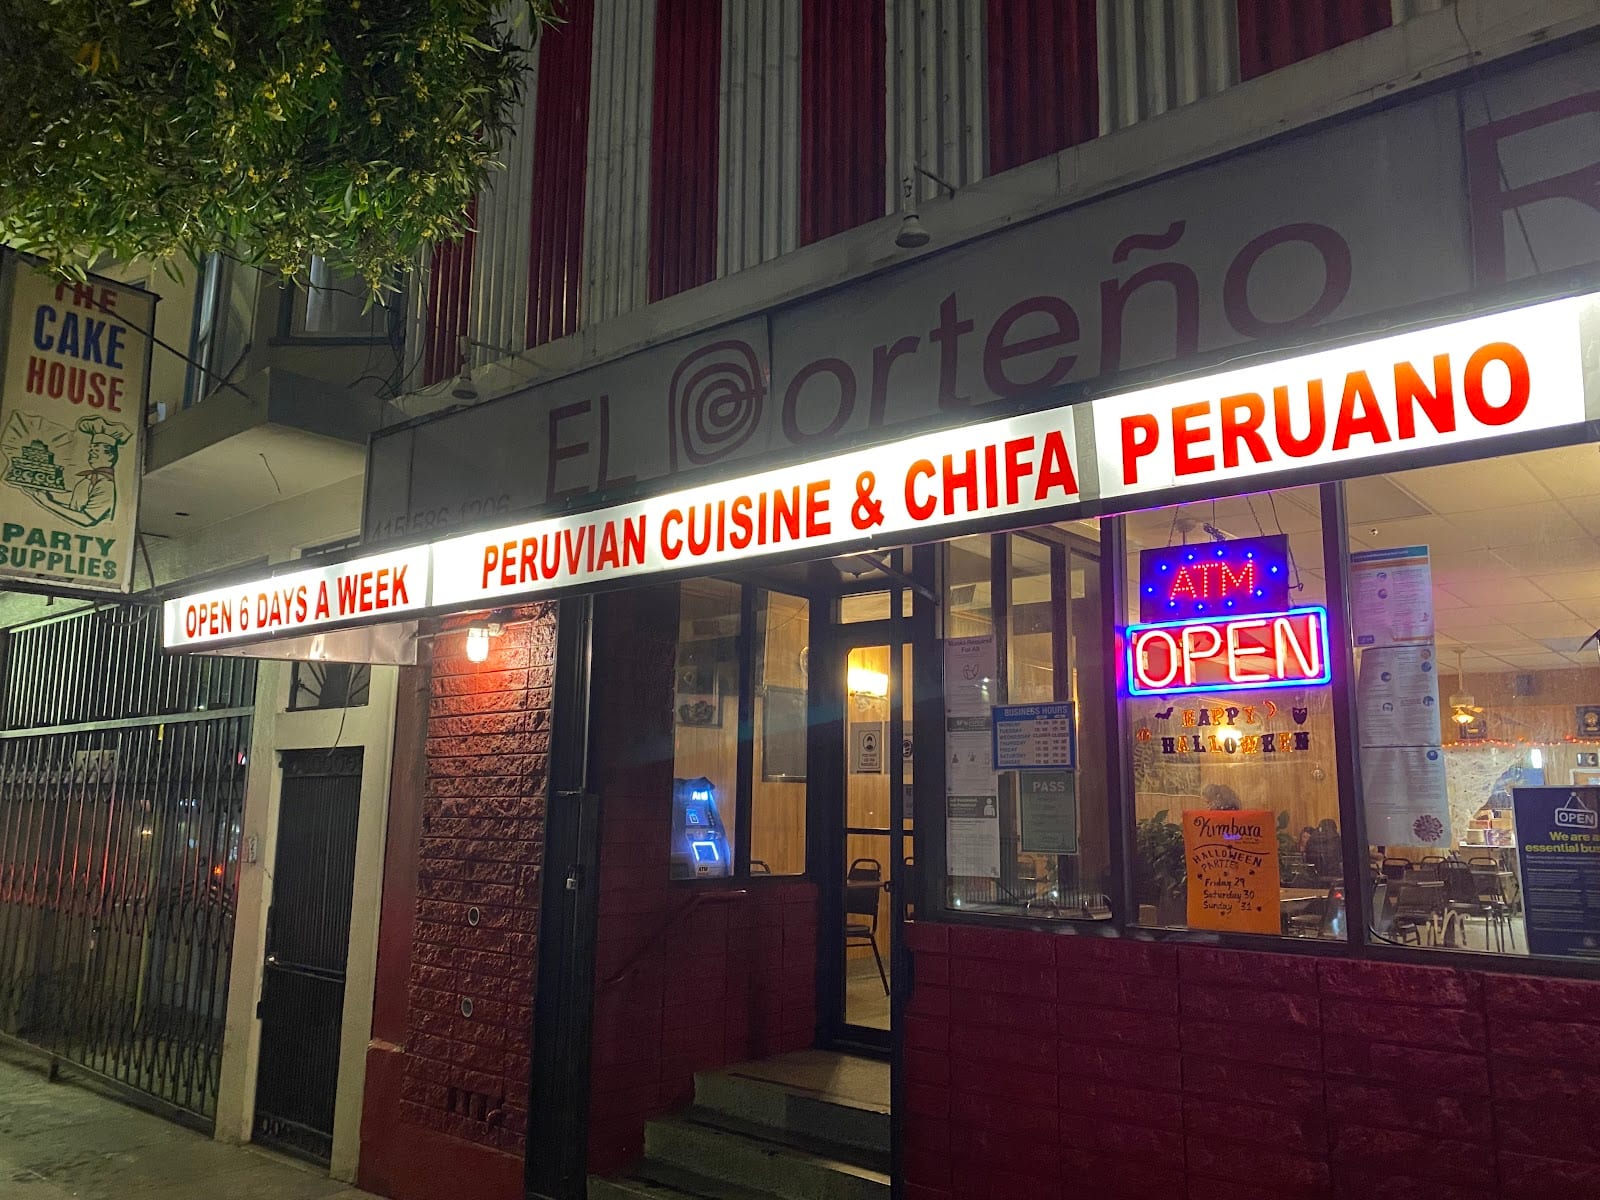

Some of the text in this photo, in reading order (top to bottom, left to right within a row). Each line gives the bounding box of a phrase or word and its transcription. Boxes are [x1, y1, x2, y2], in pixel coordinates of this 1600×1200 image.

[33, 304, 127, 370] CAKE
[26, 355, 124, 413] HOUSE
[1121, 341, 1531, 486] PERUANO
[547, 394, 637, 503] EL
[482, 430, 1079, 589] PERUVIAN CUISINE & CHIFA
[2, 522, 116, 558] PARTY
[0, 544, 117, 580] SUPPLIES
[1170, 559, 1254, 600] ATM
[186, 564, 409, 638] OPEN 6 DAYS A WEEK
[1135, 614, 1321, 688] OPEN
[1004, 705, 1068, 717] BUSINESS HOURS
[1181, 706, 1257, 728] HAPPY
[1161, 731, 1310, 754] HALLOWEEN
[1032, 781, 1066, 793] PASS
[1559, 812, 1594, 825] OPEN
[1525, 843, 1579, 853] essential
[1549, 831, 1569, 842] We
[1570, 833, 1590, 842] are
[1192, 850, 1263, 867] HALLOWEEN
[1204, 877, 1246, 890] Friday 29
[1203, 889, 1255, 903] Saturday 30
[1203, 901, 1233, 914] Sunday
